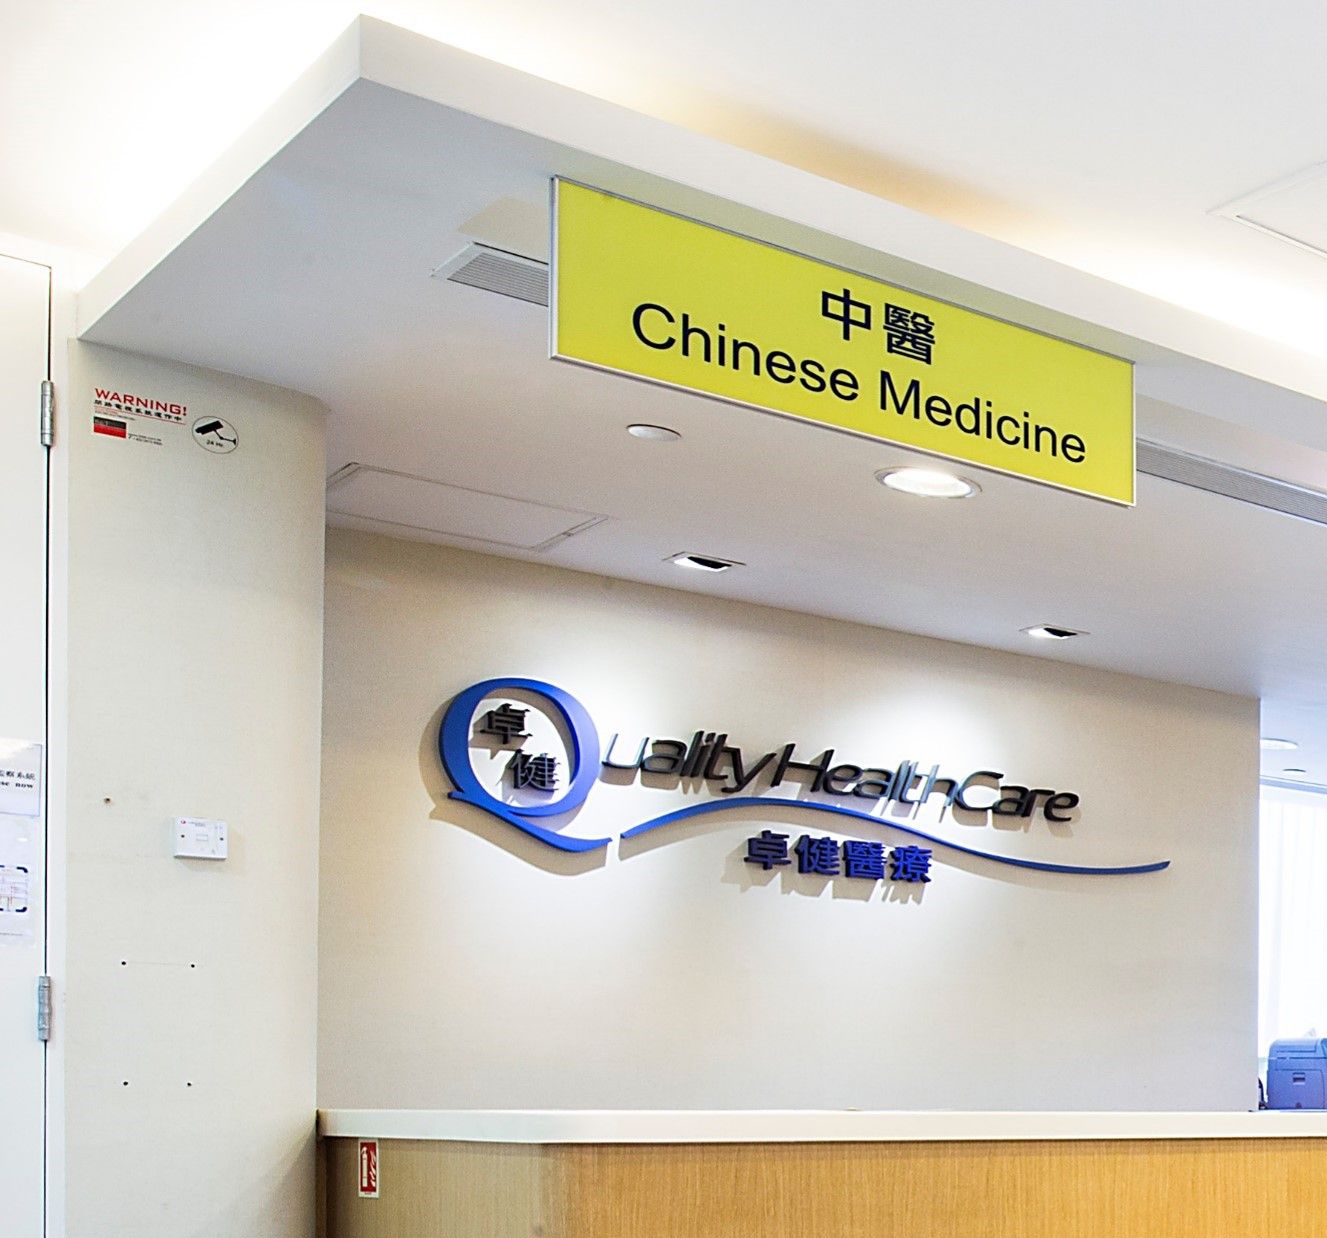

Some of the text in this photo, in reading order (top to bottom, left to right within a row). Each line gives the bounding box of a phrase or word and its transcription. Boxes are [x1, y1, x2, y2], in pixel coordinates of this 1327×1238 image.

[821, 287, 936, 366] 中醫
[95, 388, 188, 416] WARNING!
[631, 302, 1087, 465] Chinese Medicine
[480, 702, 558, 794] 卓健
[746, 830, 933, 885] 卓健醫療
